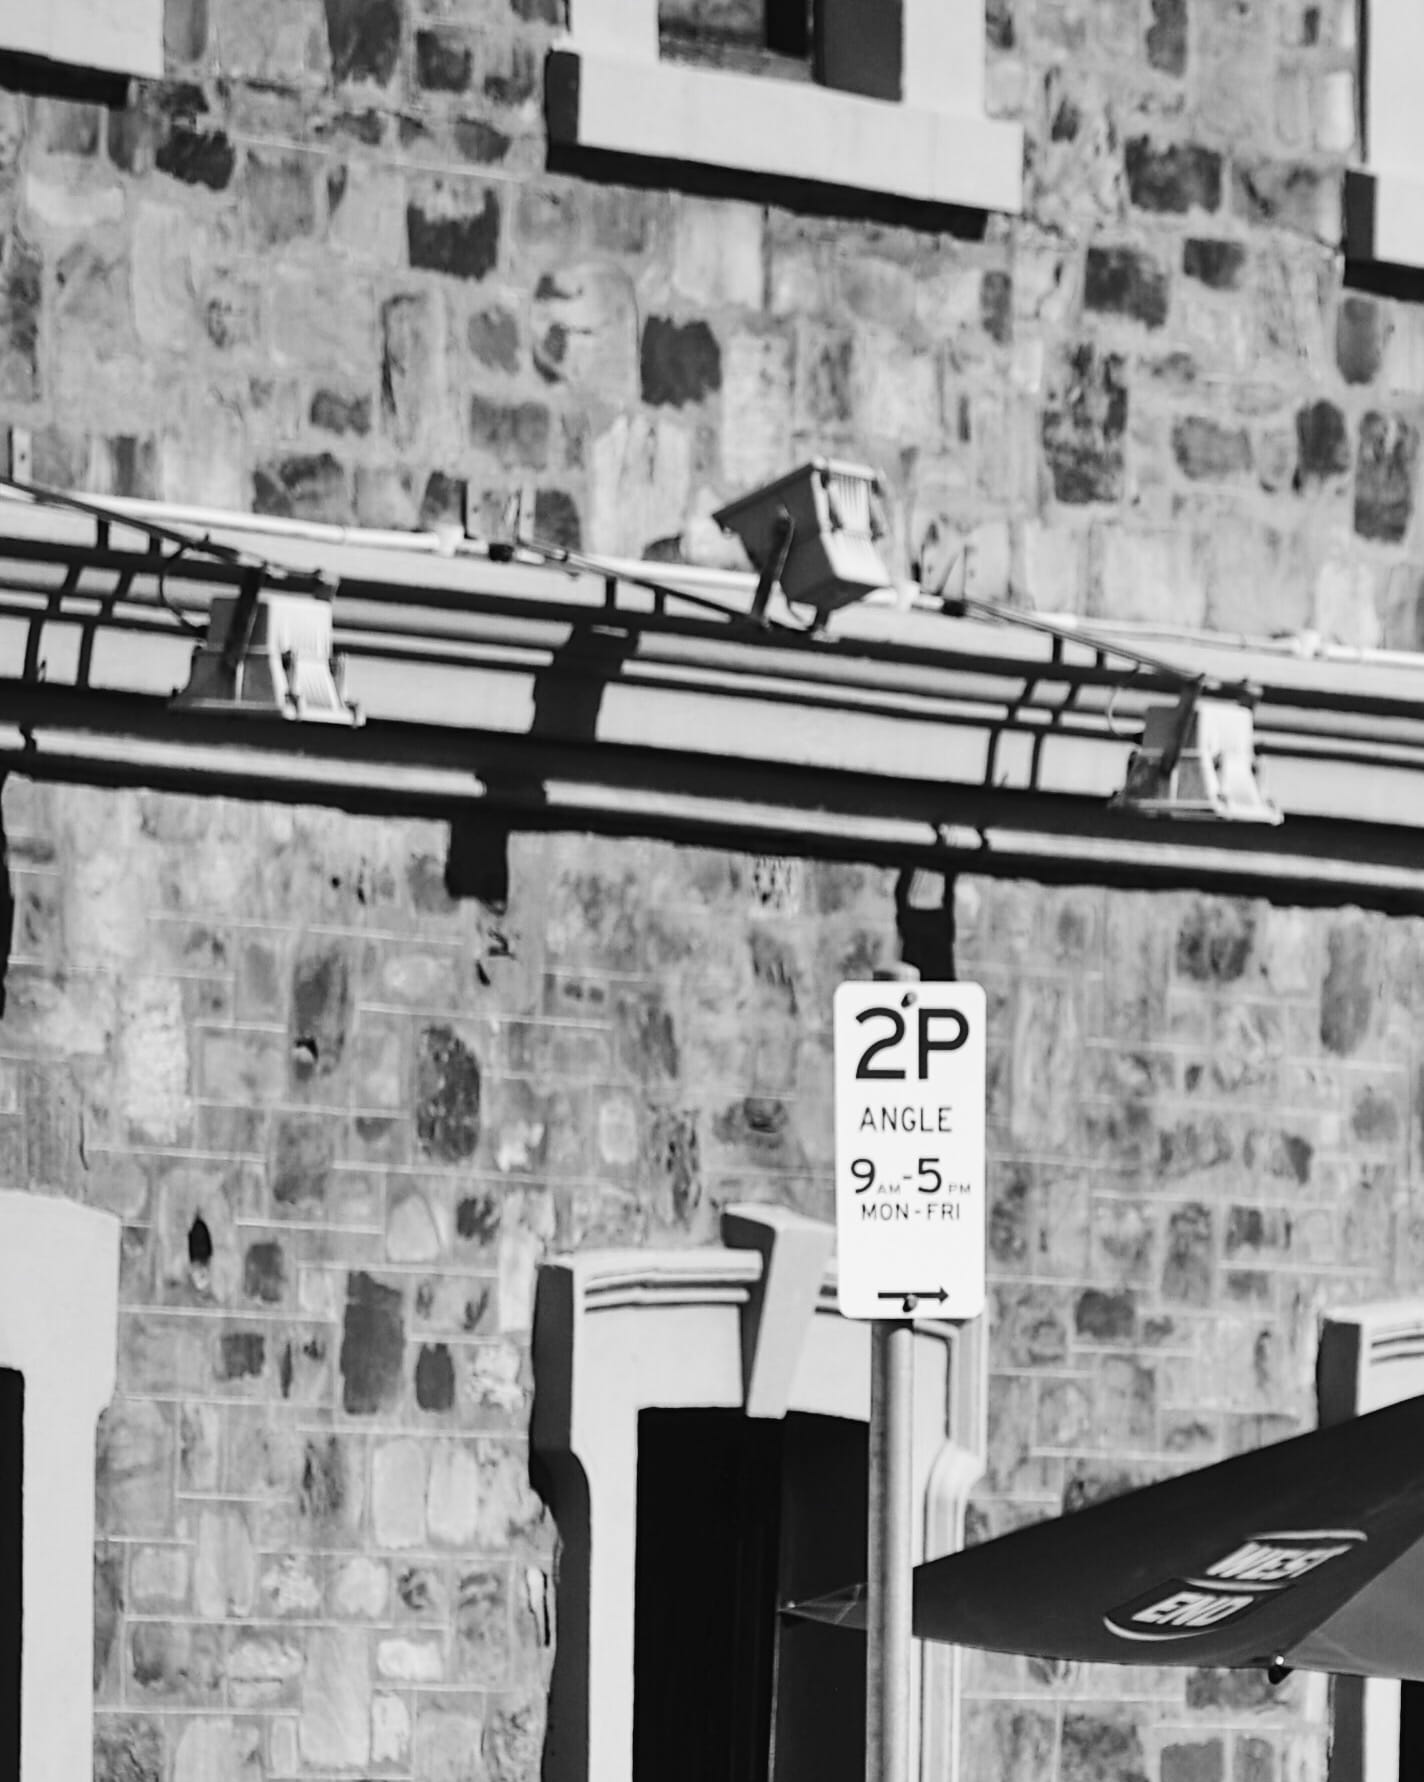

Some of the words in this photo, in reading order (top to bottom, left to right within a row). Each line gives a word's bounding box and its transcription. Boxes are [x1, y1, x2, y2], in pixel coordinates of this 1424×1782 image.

[855, 1006, 970, 1080] 2P
[859, 1106, 953, 1133] ANGLE
[1131, 1591, 1254, 1627] END
